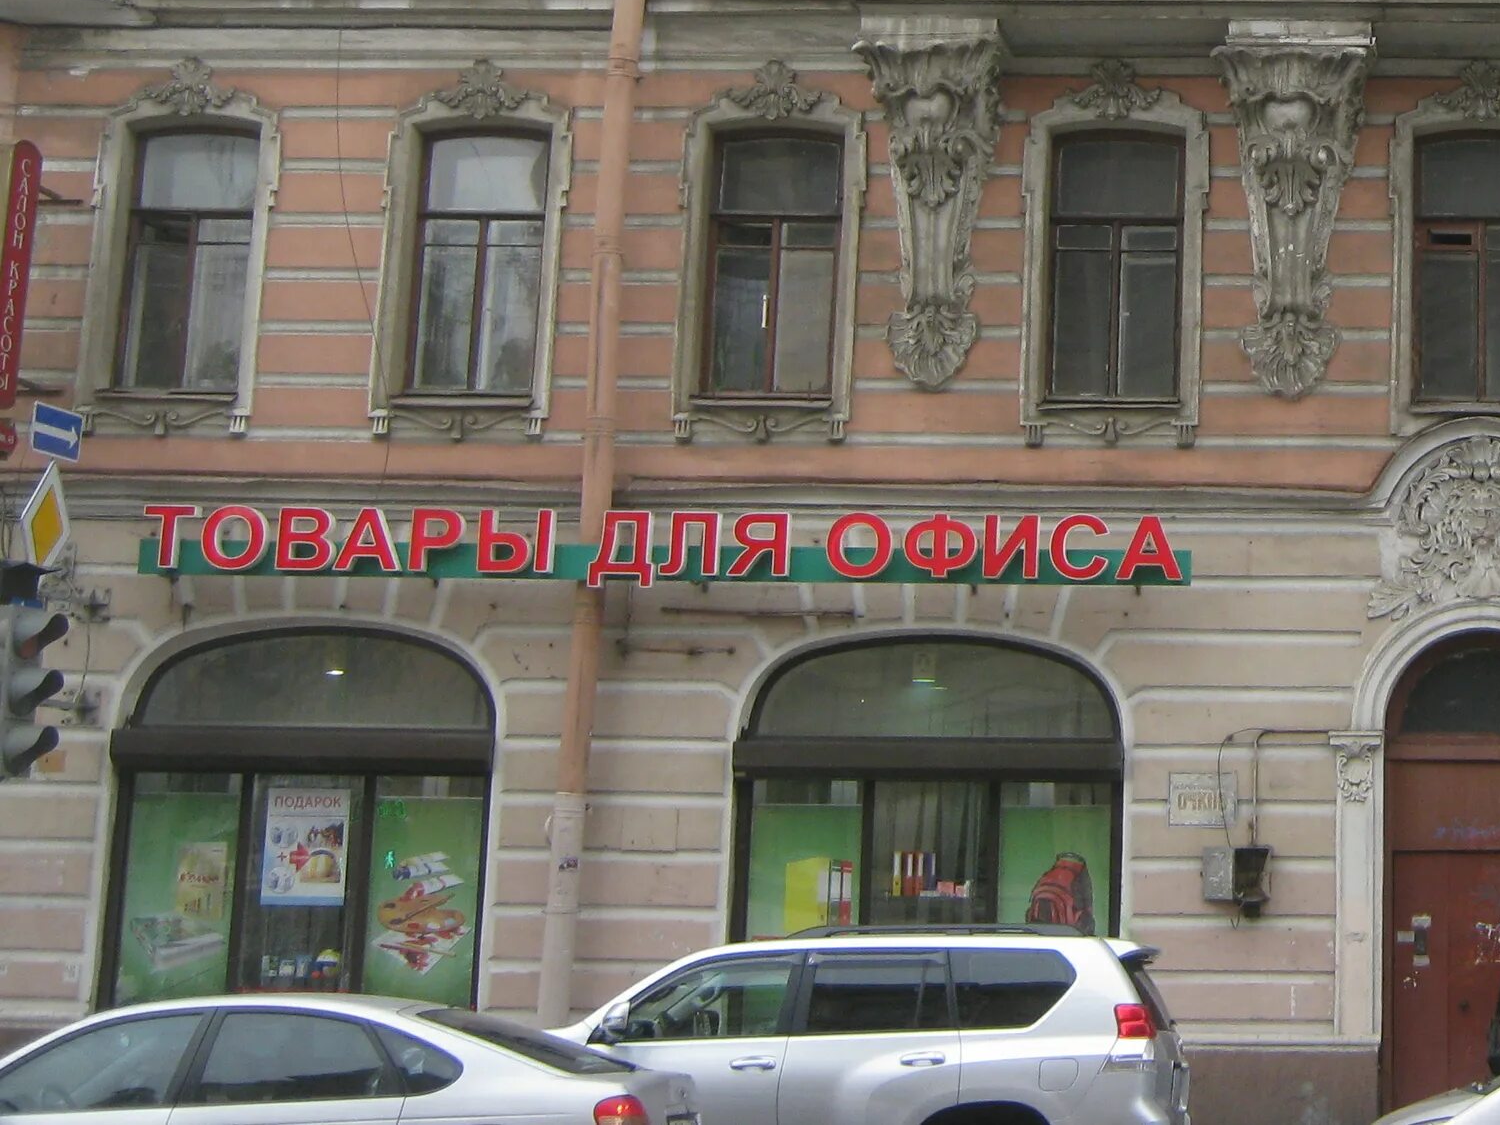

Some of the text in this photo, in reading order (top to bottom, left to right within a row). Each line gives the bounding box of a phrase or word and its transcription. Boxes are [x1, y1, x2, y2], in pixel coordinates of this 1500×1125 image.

[0, 158, 31, 391] САЛОН КРАСОТЫ
[144, 505, 1184, 588] ТОВАРЫ ДЛЯ ОФИСА
[274, 796, 342, 810] ПОДАРОК
